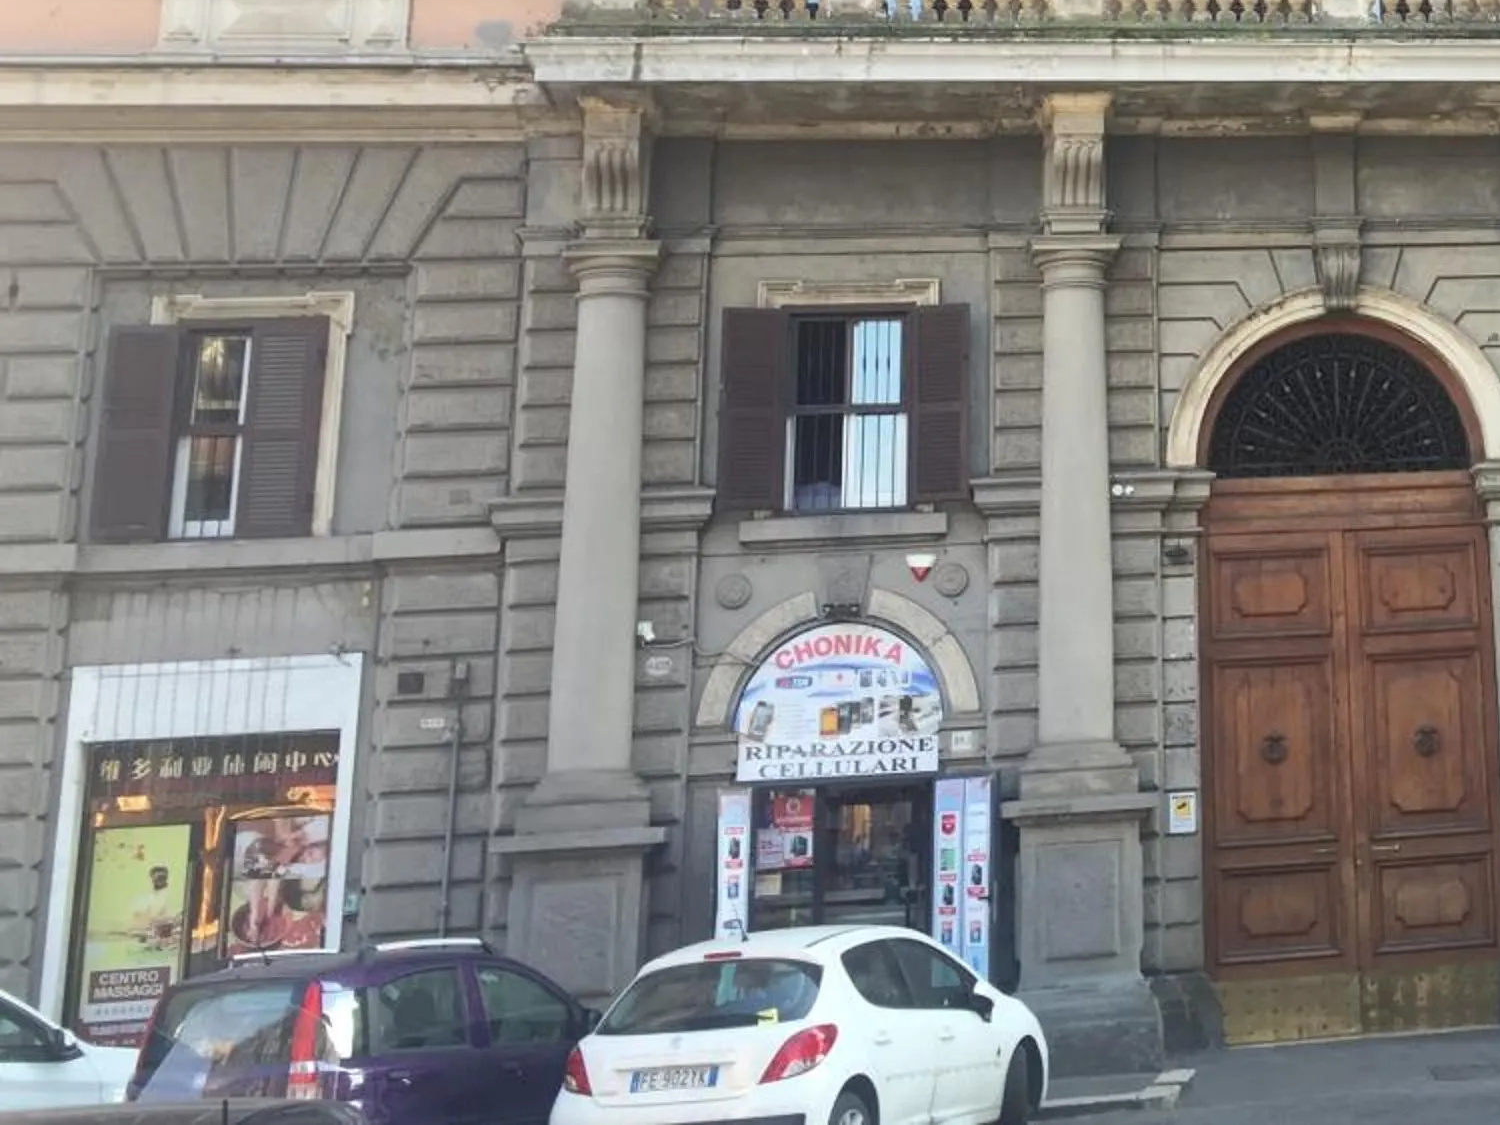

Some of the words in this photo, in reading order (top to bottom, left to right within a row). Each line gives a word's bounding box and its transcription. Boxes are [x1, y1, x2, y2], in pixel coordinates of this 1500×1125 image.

[774, 634, 904, 670] CHONIKA
[744, 736, 935, 761] RIPARAZIONE
[758, 756, 919, 779] CELLULARI
[98, 970, 159, 986] CENTRO
